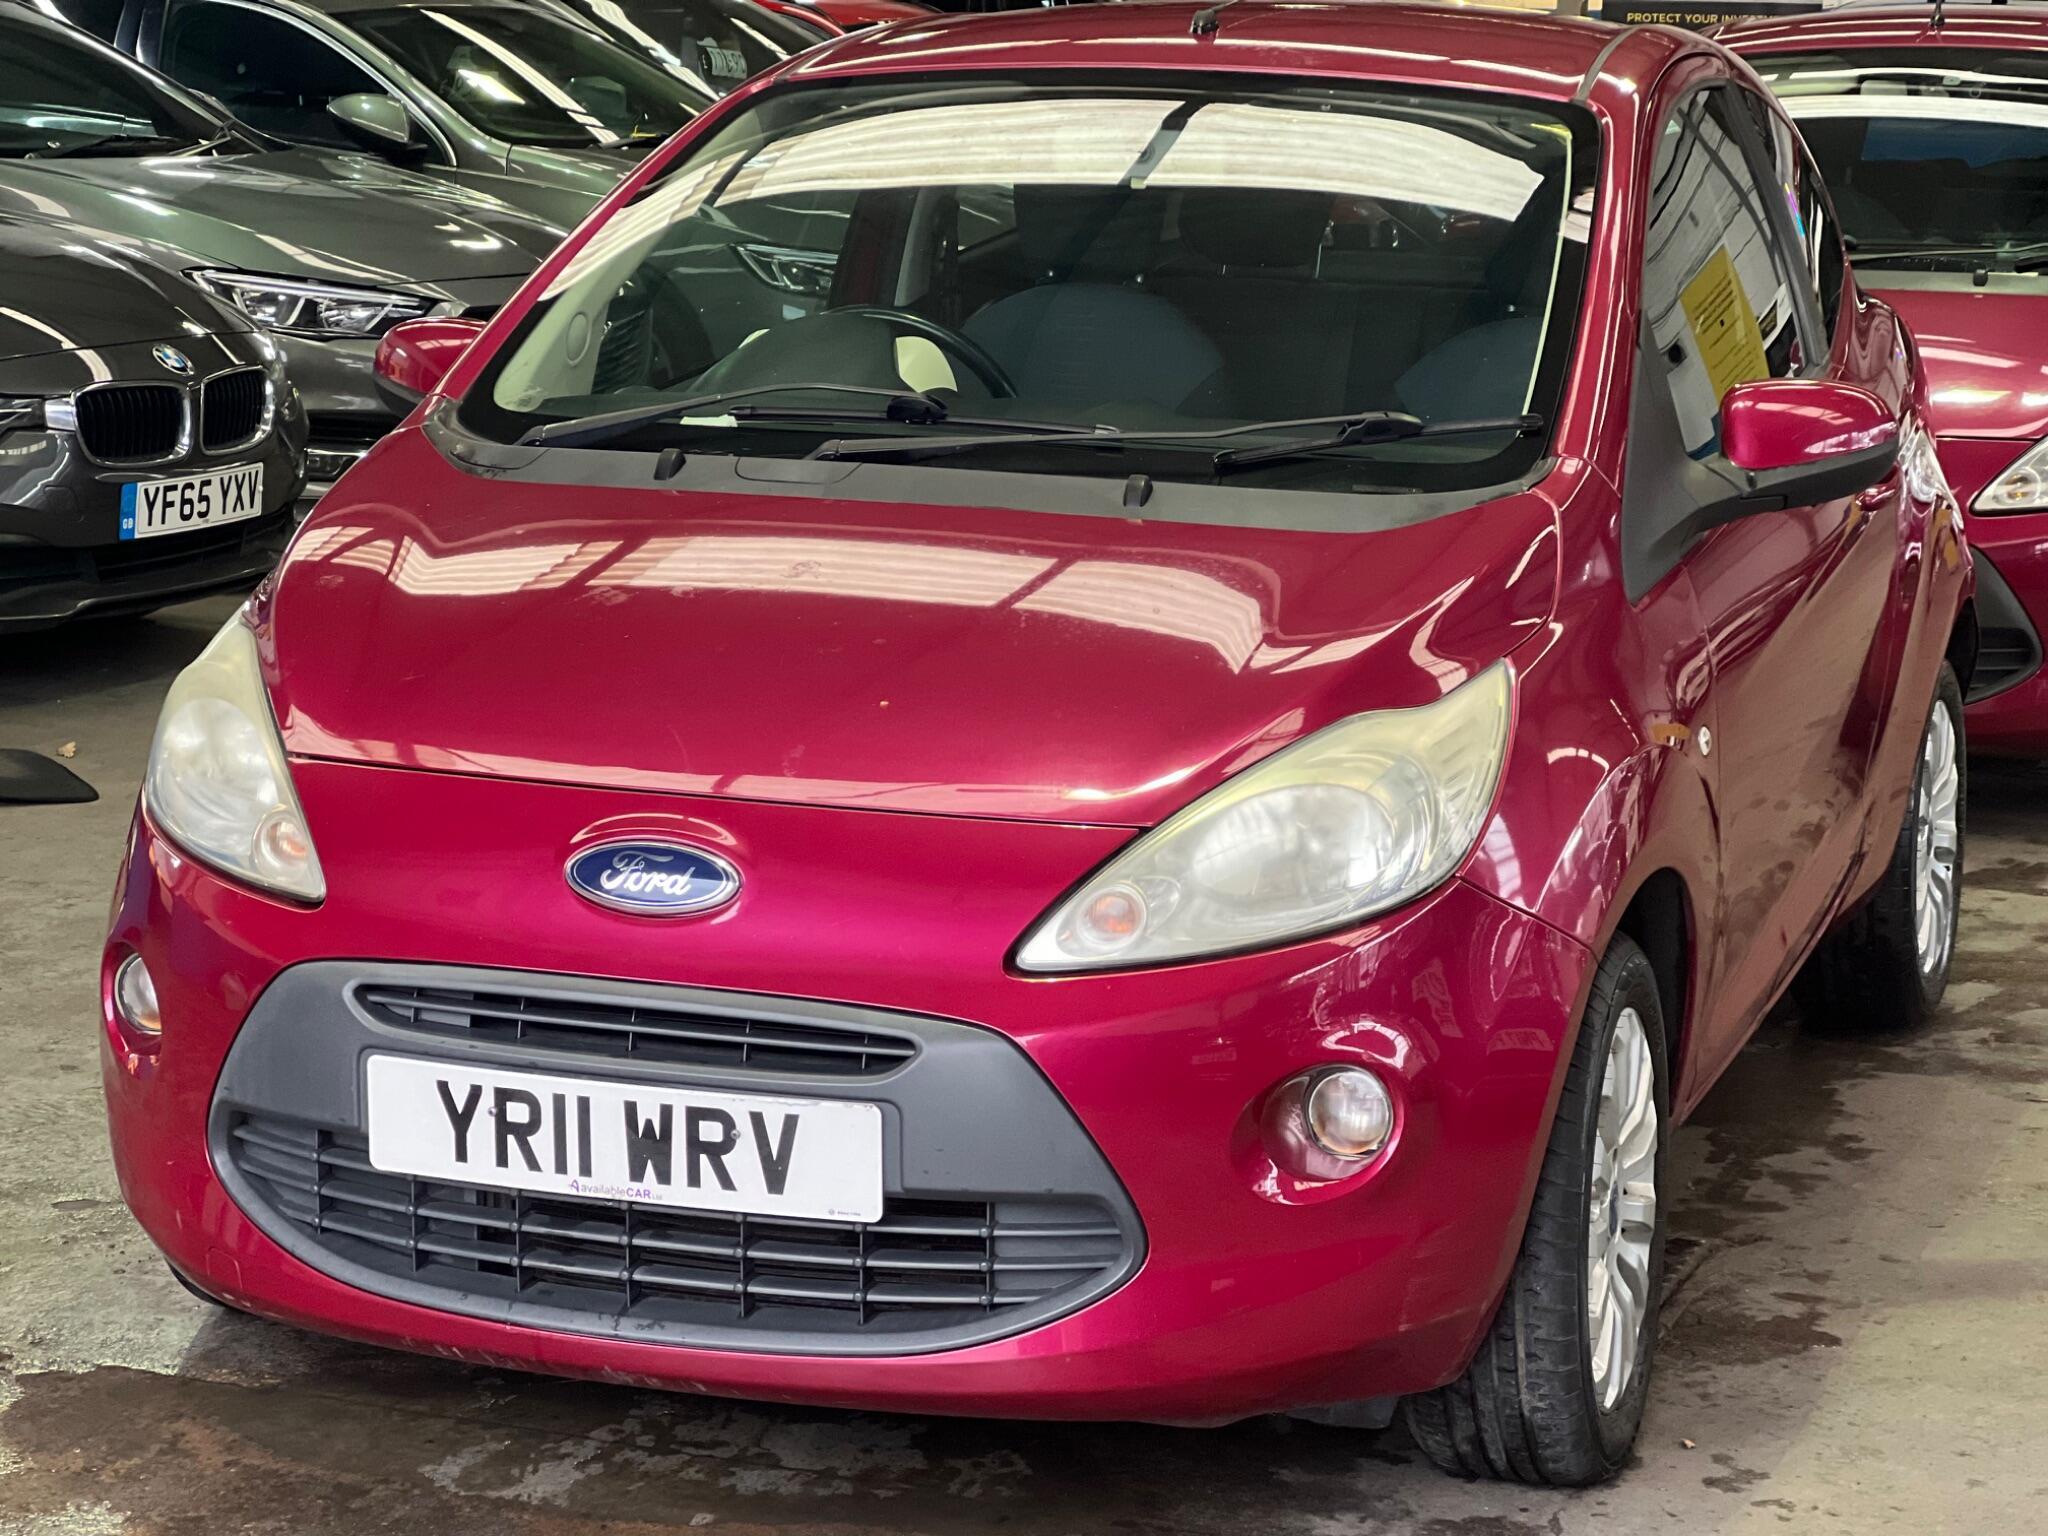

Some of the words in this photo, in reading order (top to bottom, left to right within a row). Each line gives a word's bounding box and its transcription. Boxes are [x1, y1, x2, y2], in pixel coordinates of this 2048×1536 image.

[1626, 12, 1682, 24] PROTECT
[1685, 13, 1719, 24] YOUR
[143, 479, 212, 527] YF65
[220, 470, 259, 515] YXV
[600, 850, 696, 896] Ford
[435, 1079, 593, 1178] YR11
[623, 1099, 800, 1196] WRV
